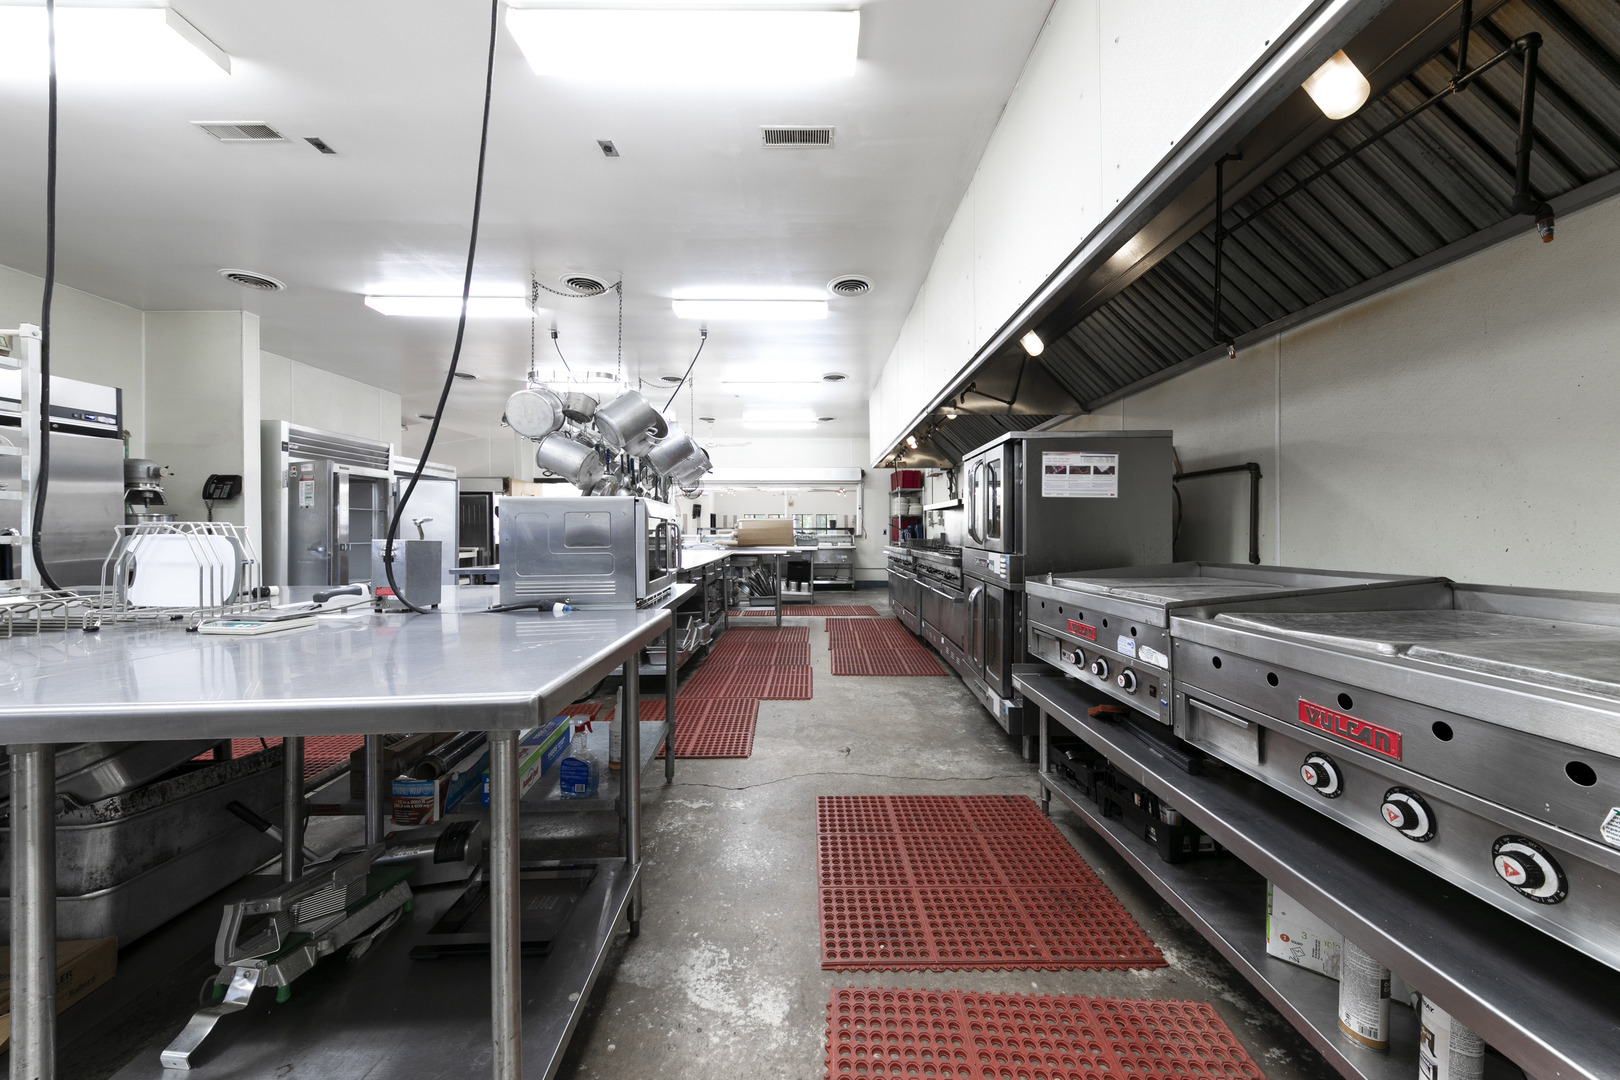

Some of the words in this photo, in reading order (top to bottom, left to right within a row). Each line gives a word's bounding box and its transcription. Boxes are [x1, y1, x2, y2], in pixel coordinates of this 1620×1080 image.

[1069, 622, 1093, 638] VULCAN
[1304, 704, 1390, 753] VULCAN
[1301, 931, 1308, 940] 3
